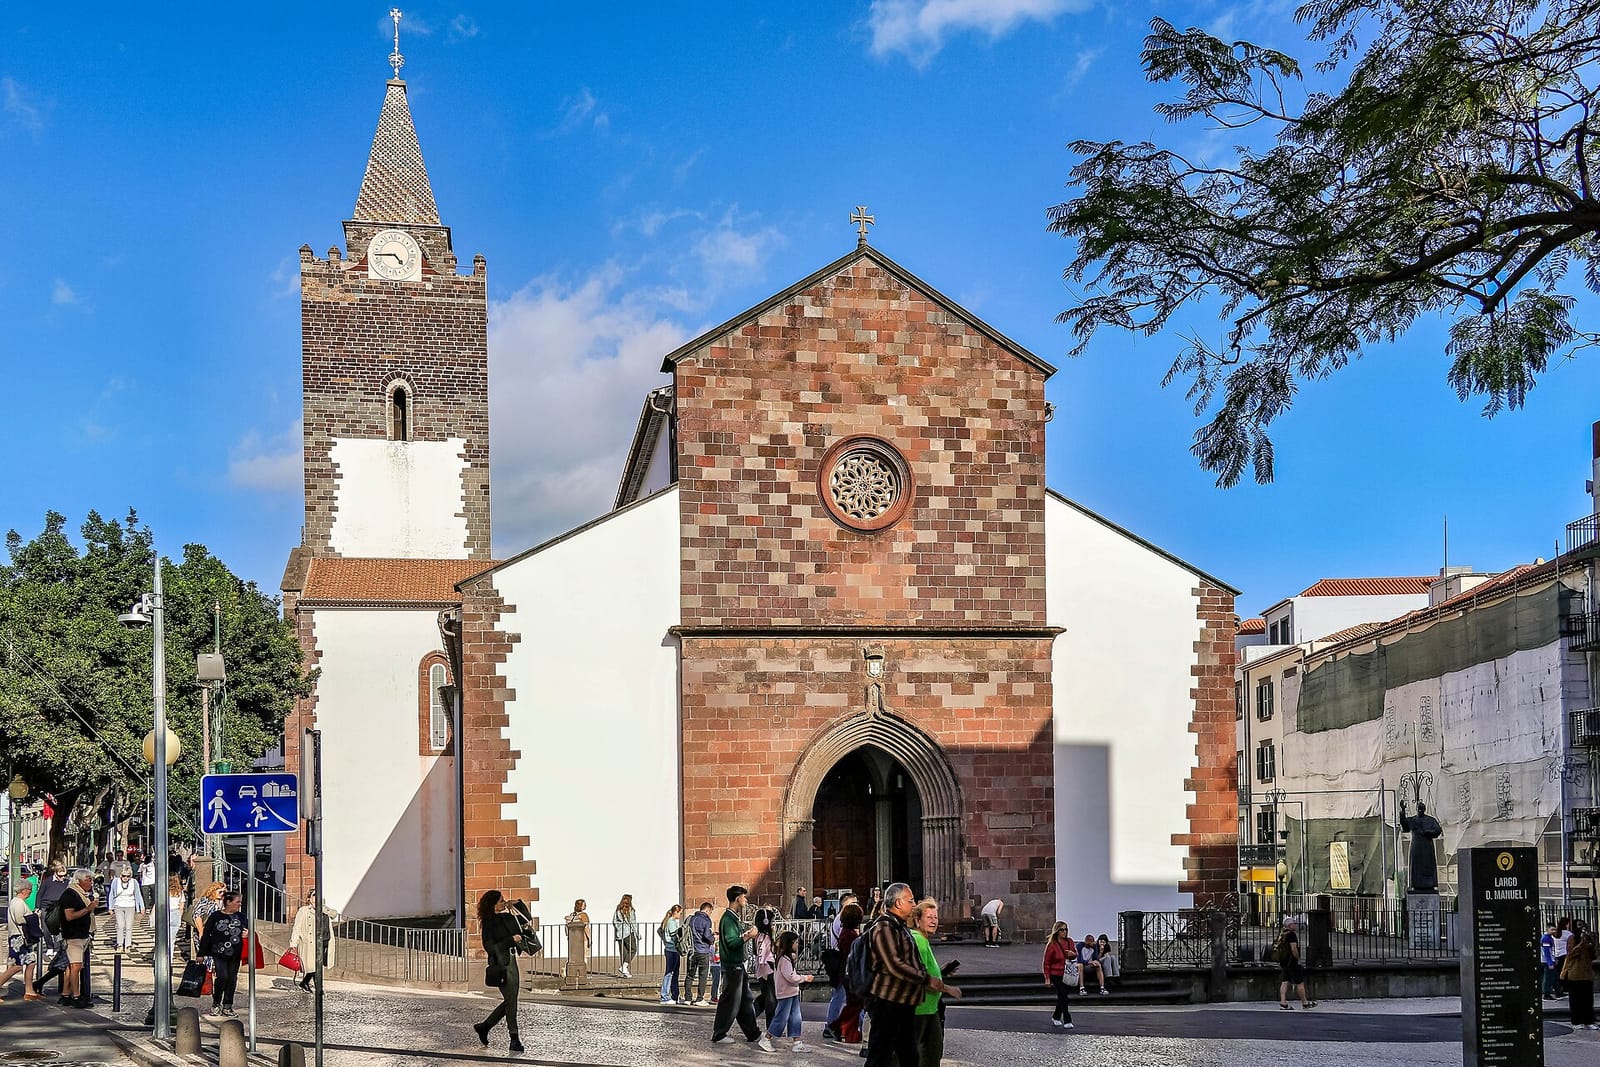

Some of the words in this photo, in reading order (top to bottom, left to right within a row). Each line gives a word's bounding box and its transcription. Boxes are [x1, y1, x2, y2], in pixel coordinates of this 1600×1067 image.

[1494, 877, 1518, 888] LARGO
[1485, 890, 1493, 900] D.
[1494, 890, 1523, 900] MANUEL
